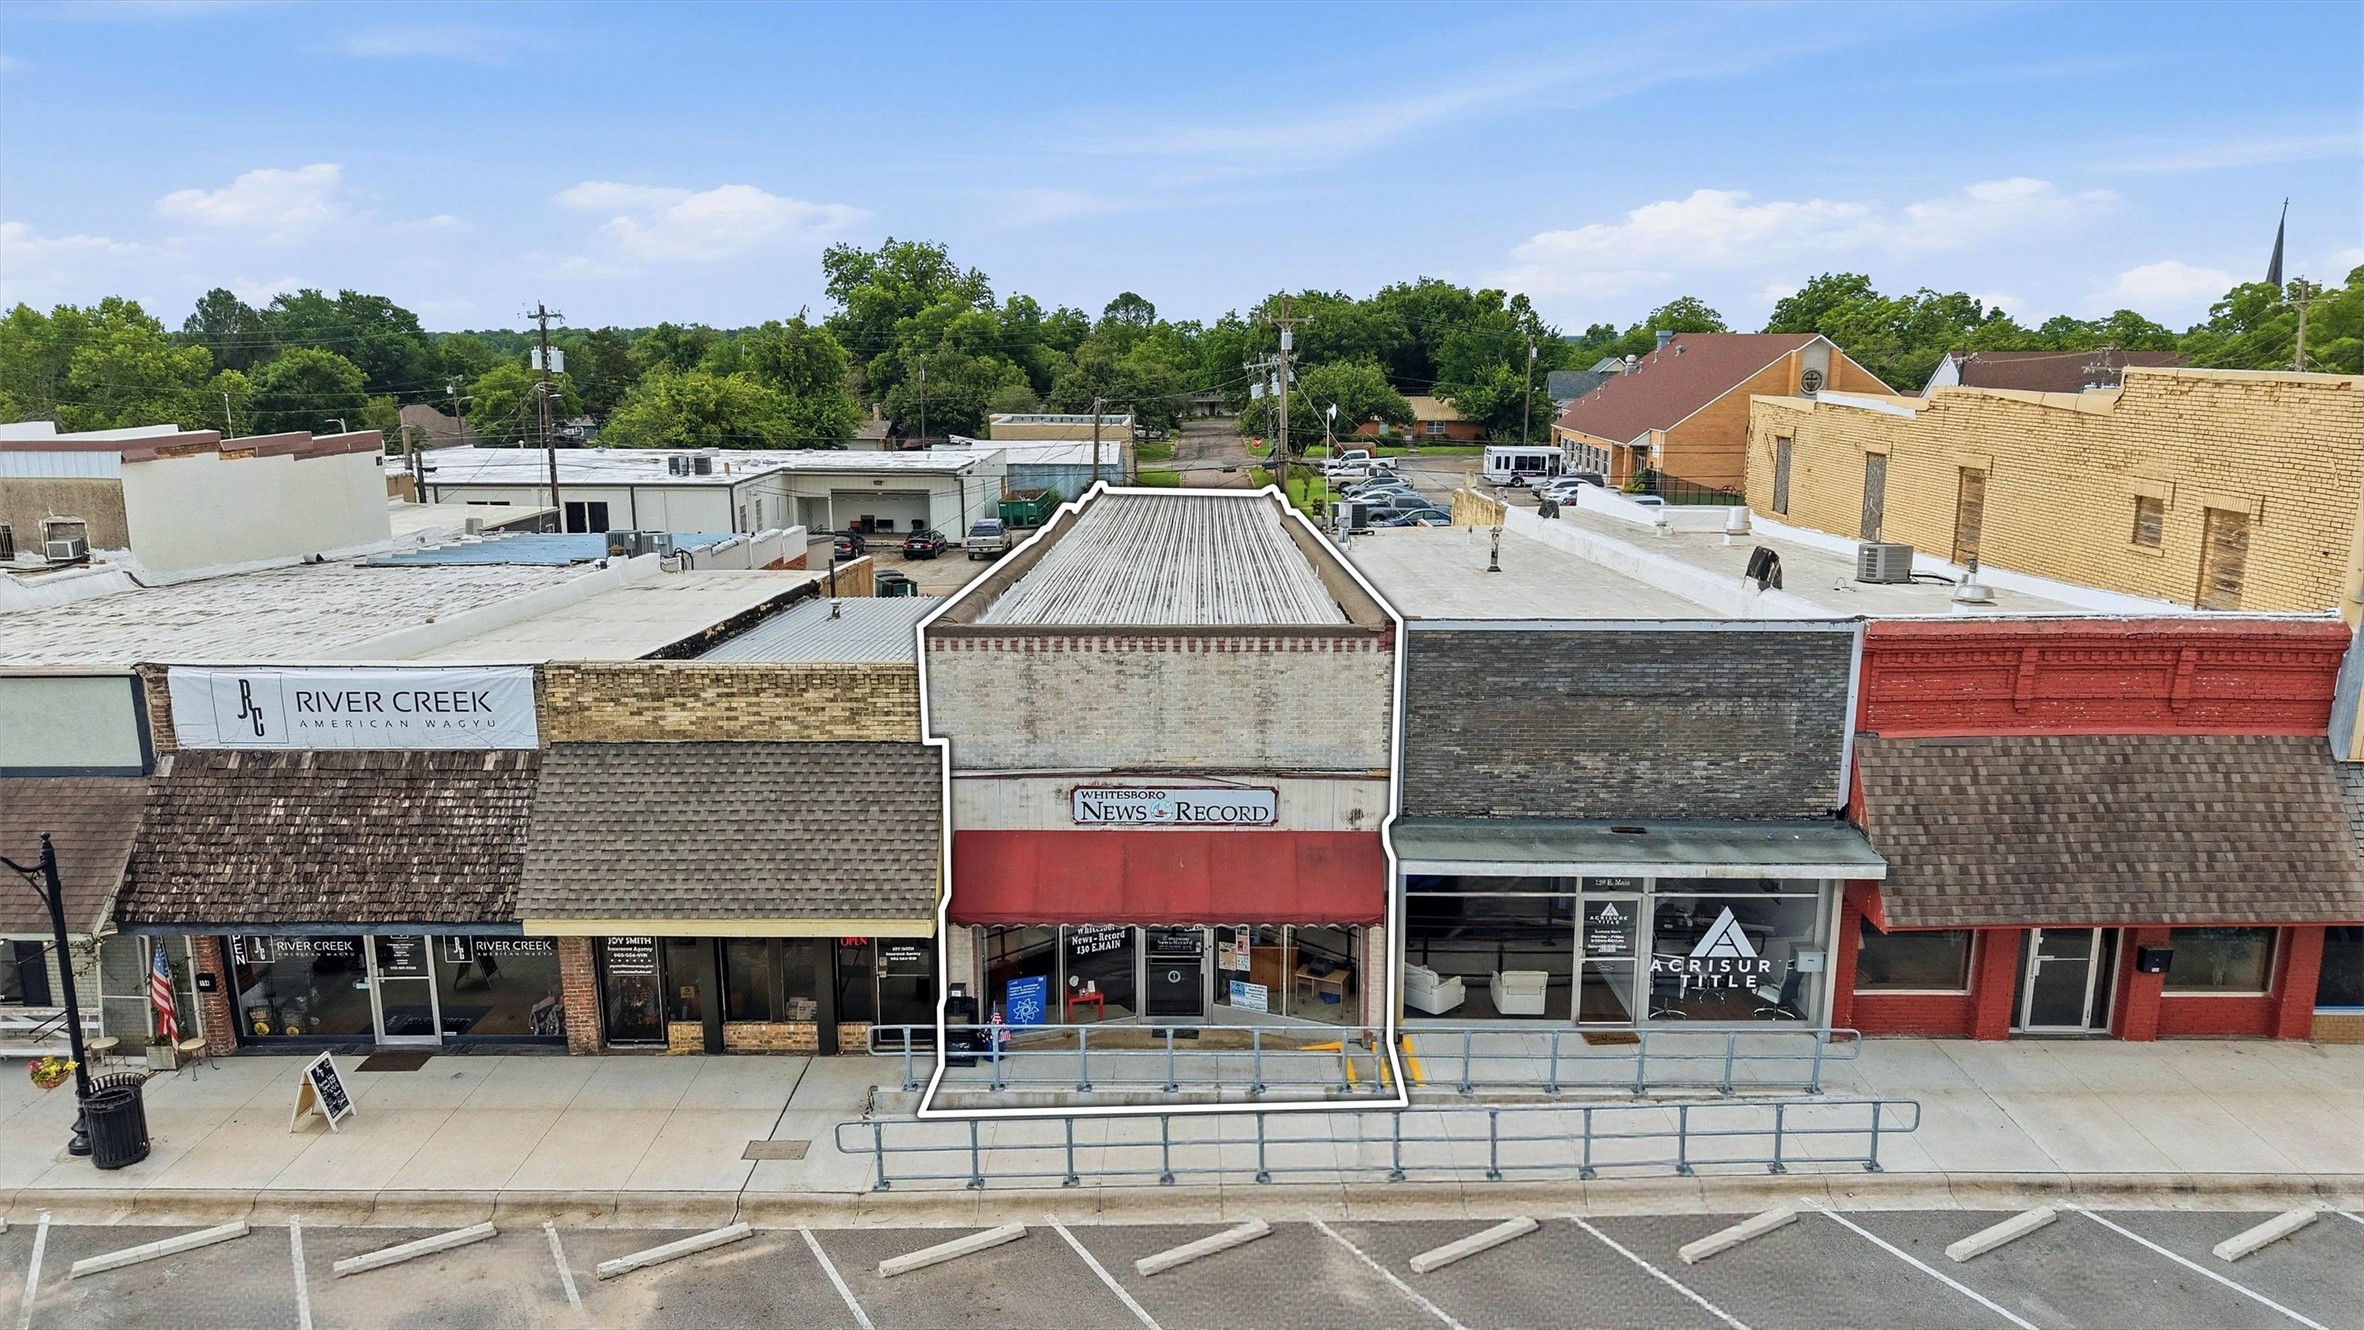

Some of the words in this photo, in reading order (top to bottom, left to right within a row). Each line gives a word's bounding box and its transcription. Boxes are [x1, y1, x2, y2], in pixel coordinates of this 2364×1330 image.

[296, 691, 384, 713] RIVER
[393, 691, 493, 713] CREEK
[299, 720, 409, 729] AMERICAN
[425, 719, 496, 728] WAGYU
[1081, 791, 1166, 800] WHITESBORO
[1081, 801, 1147, 821] NEWS
[1175, 802, 1269, 821] RECORD
[608, 936, 624, 945] JOY
[625, 937, 652, 945] SMITH
[840, 936, 868, 946] OPEN
[232, 934, 246, 966] PEN
[276, 941, 311, 951] RIVER
[313, 941, 353, 951] CREEK
[476, 941, 510, 951] RIVER
[512, 941, 552, 951] CREEK
[1076, 945, 1090, 955] 130
[1649, 959, 1771, 974] ACRISUR
[1681, 975, 1757, 988] TITLE
